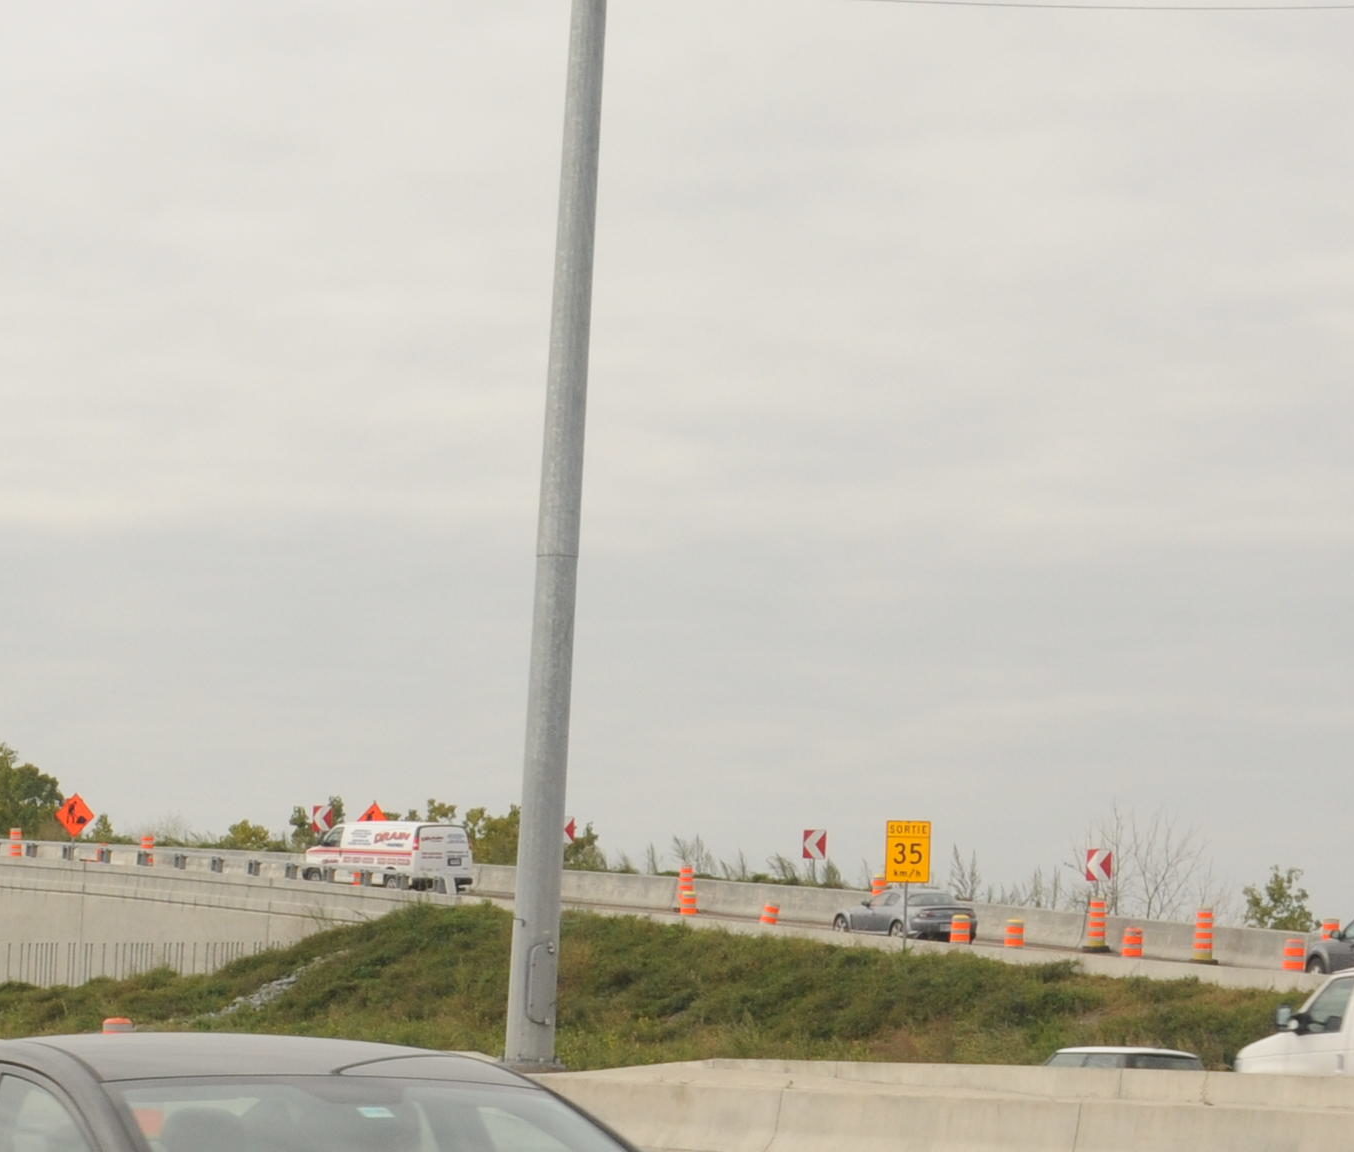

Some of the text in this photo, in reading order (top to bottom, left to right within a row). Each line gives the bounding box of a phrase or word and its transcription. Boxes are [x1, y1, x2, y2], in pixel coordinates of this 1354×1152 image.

[889, 824, 928, 834] SORTIE
[373, 831, 412, 844] DRAIN
[893, 842, 923, 865] 35
[893, 869, 922, 878] km/h
